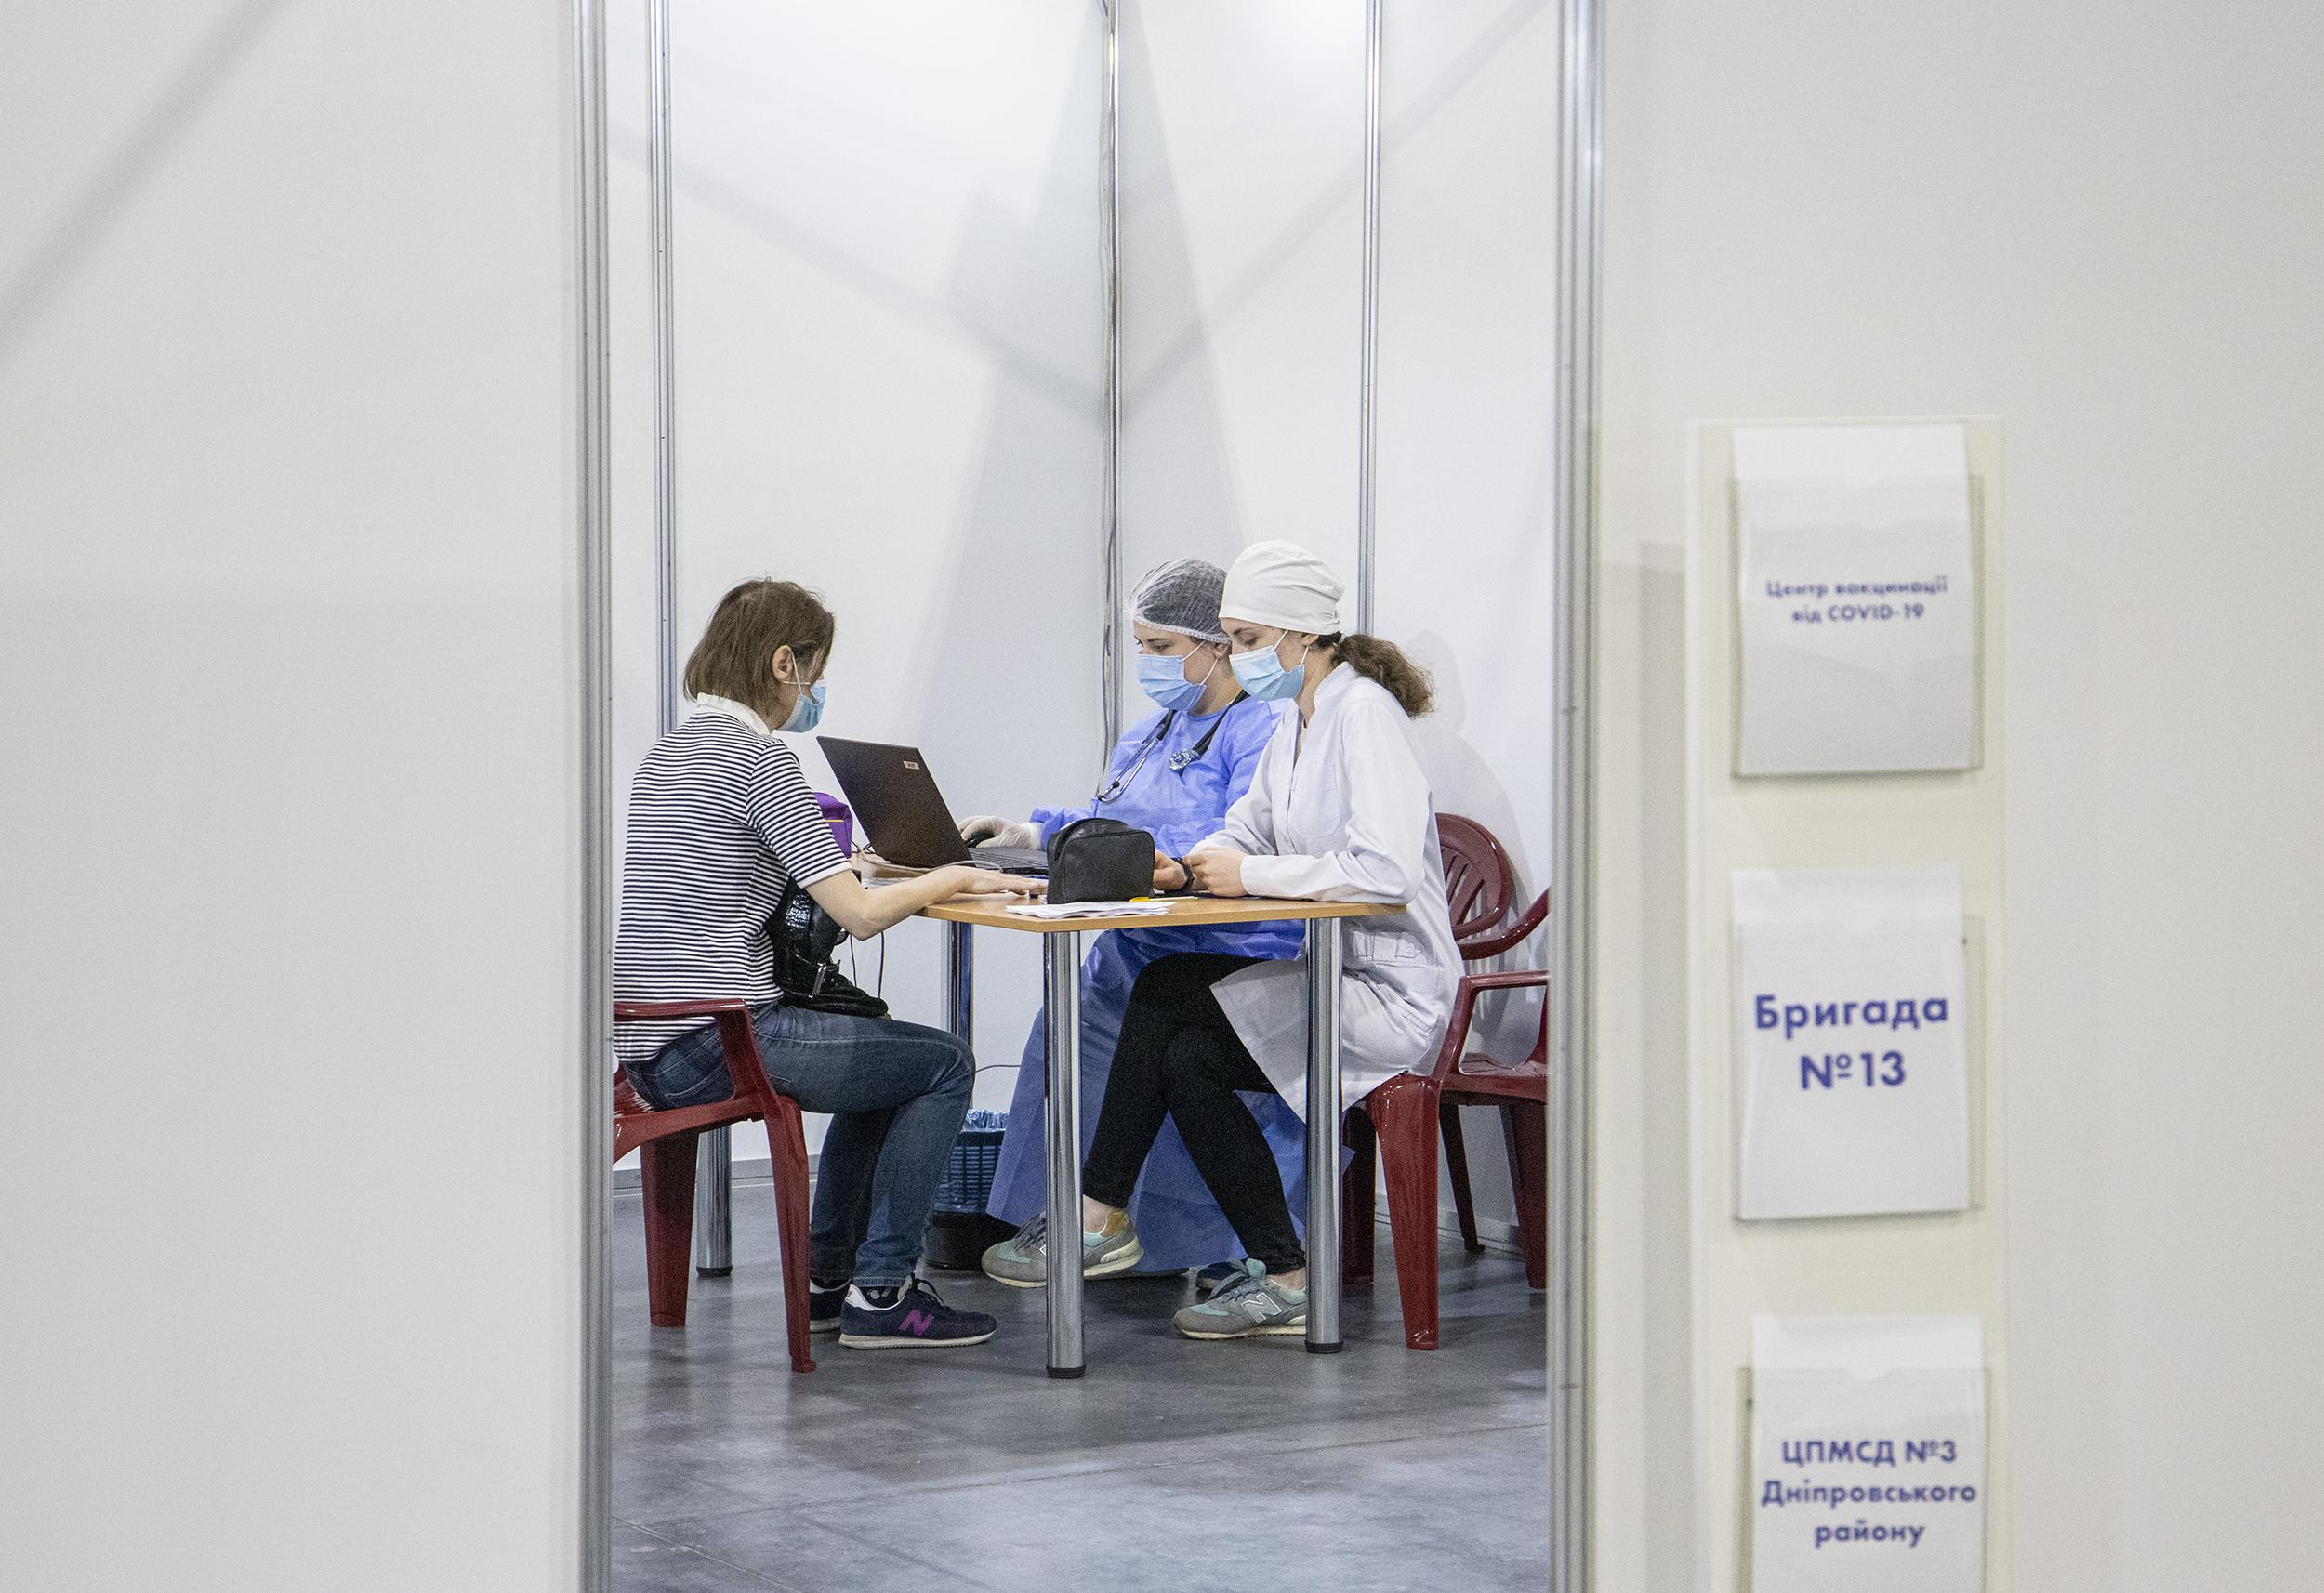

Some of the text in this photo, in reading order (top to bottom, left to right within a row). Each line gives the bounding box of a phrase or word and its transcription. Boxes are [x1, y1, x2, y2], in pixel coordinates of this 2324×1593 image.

[1766, 580, 1829, 599] Центр
[1791, 602, 1924, 624] від COVID-19
[1755, 994, 1948, 1040] Бригада
[898, 1309, 935, 1336] N
[1782, 1440, 1896, 1468] ЦПМСД
[1761, 1478, 1977, 1510] Дніпровського
[1815, 1520, 1926, 1550] району
